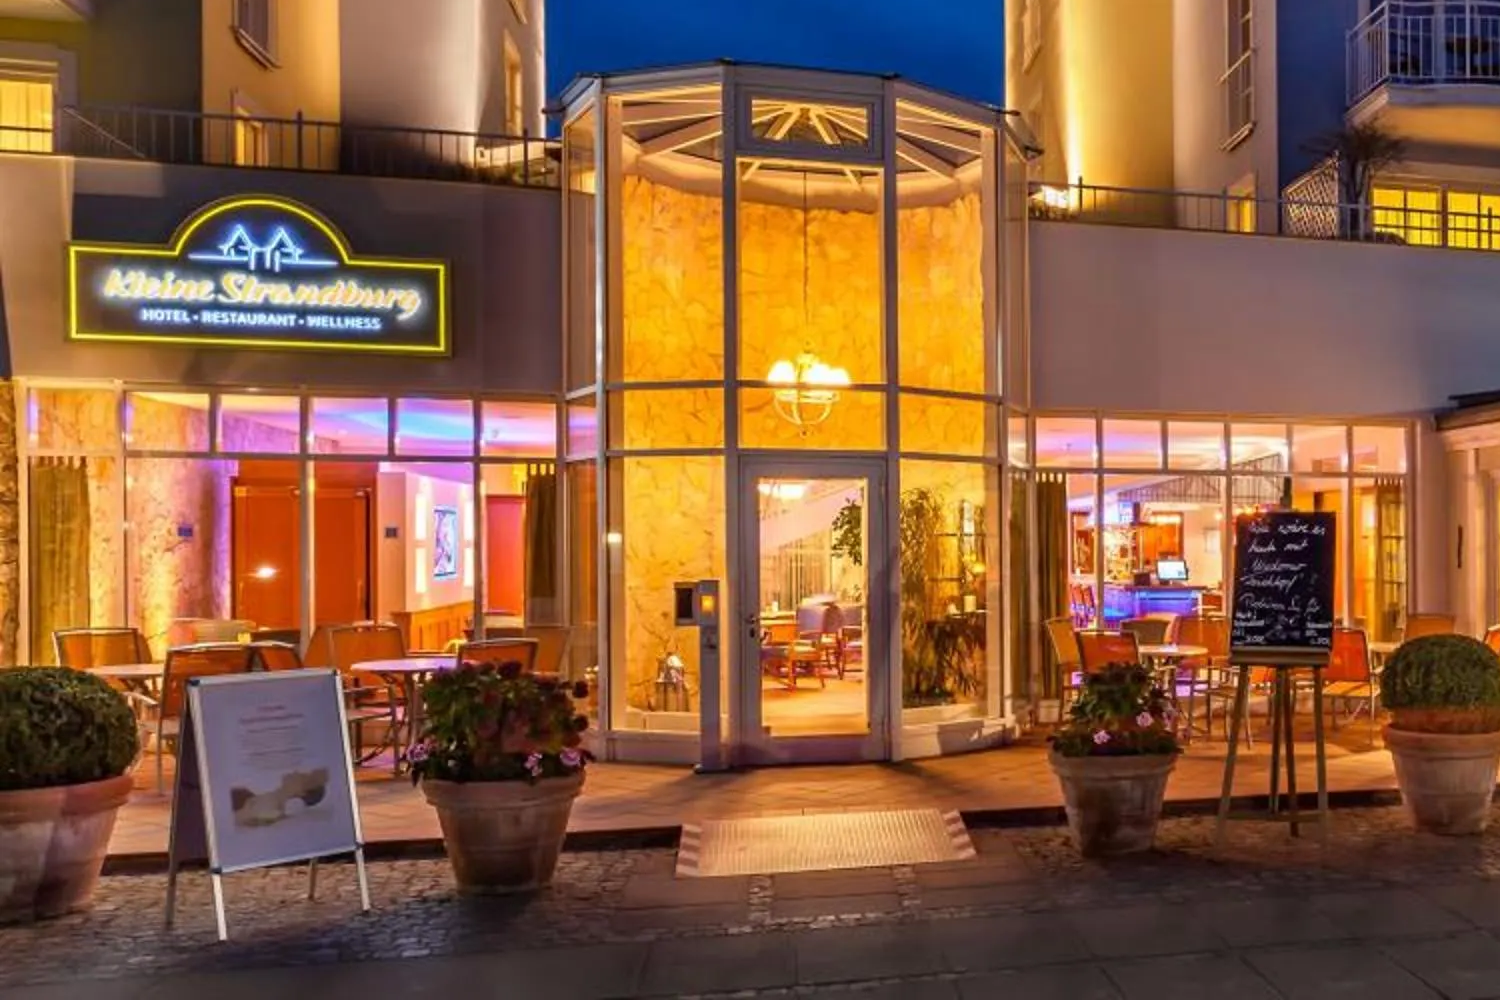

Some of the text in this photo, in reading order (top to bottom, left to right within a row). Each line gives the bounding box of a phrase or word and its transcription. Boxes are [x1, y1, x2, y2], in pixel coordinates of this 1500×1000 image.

[103, 269, 422, 321] Kleine Strandburg
[142, 308, 382, 330] HOTEL RESTAURANT WELLNESS
